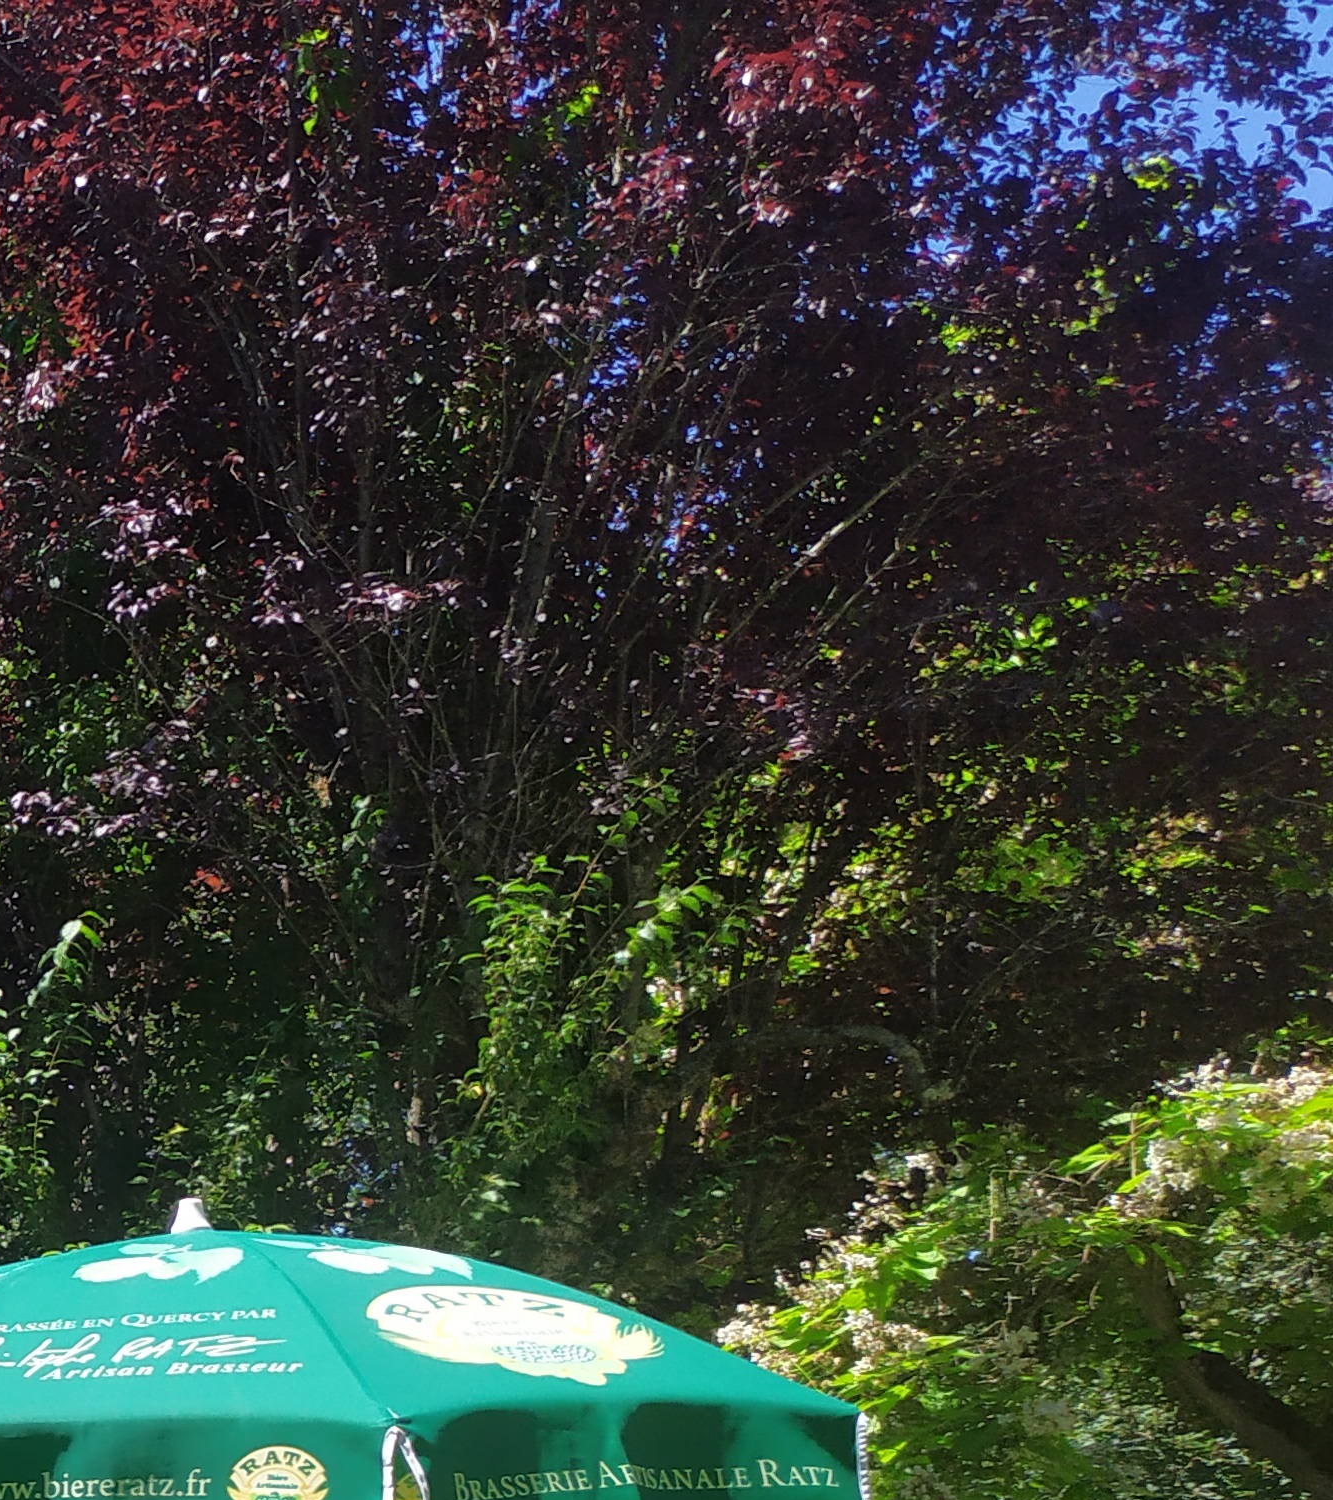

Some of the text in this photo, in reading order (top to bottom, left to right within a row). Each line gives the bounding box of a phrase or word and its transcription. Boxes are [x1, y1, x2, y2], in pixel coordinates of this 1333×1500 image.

[385, 1291, 565, 1323] RATZ
[39, 1359, 305, 1382] Artisan Brasseur
[239, 1450, 318, 1477] RATZ
